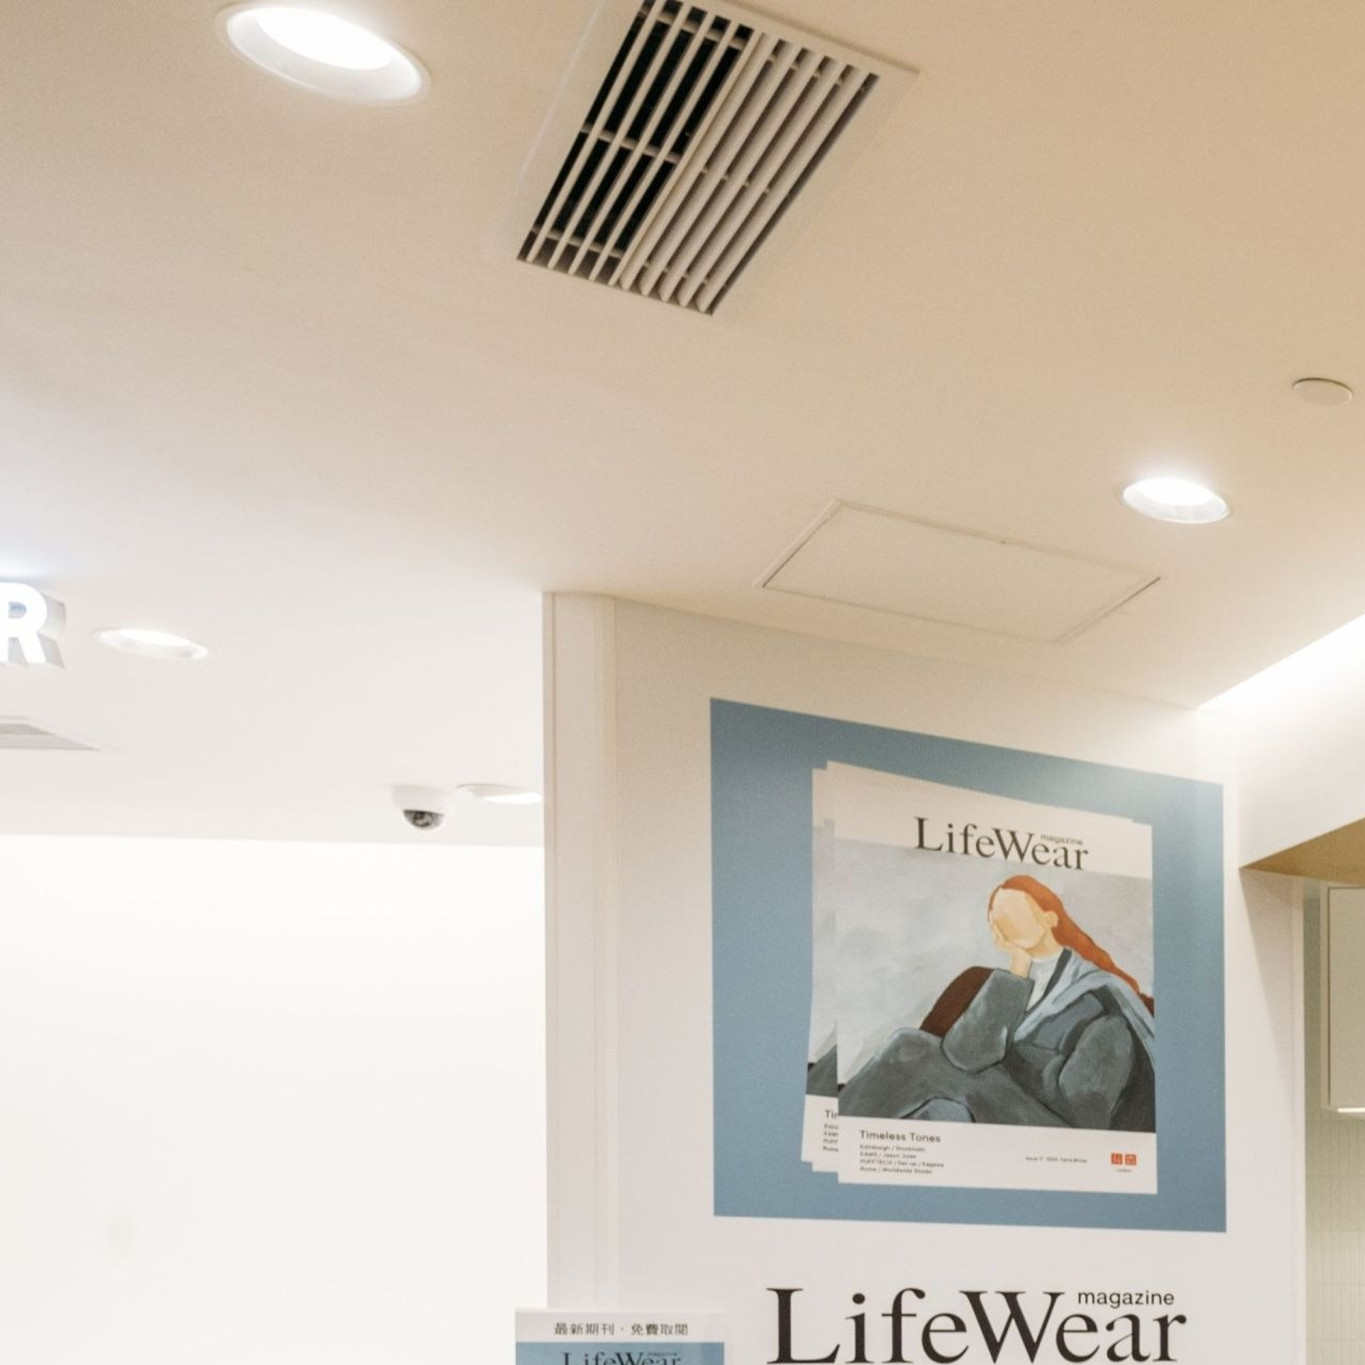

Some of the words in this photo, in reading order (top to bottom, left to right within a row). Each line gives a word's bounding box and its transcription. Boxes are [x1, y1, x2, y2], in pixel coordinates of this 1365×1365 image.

[914, 816, 1089, 870] LifeWear
[860, 1130, 906, 1141] Timeless
[910, 1132, 941, 1143] Tones
[766, 1287, 1187, 1365] LifeWear
[1078, 1290, 1174, 1308] magazine
